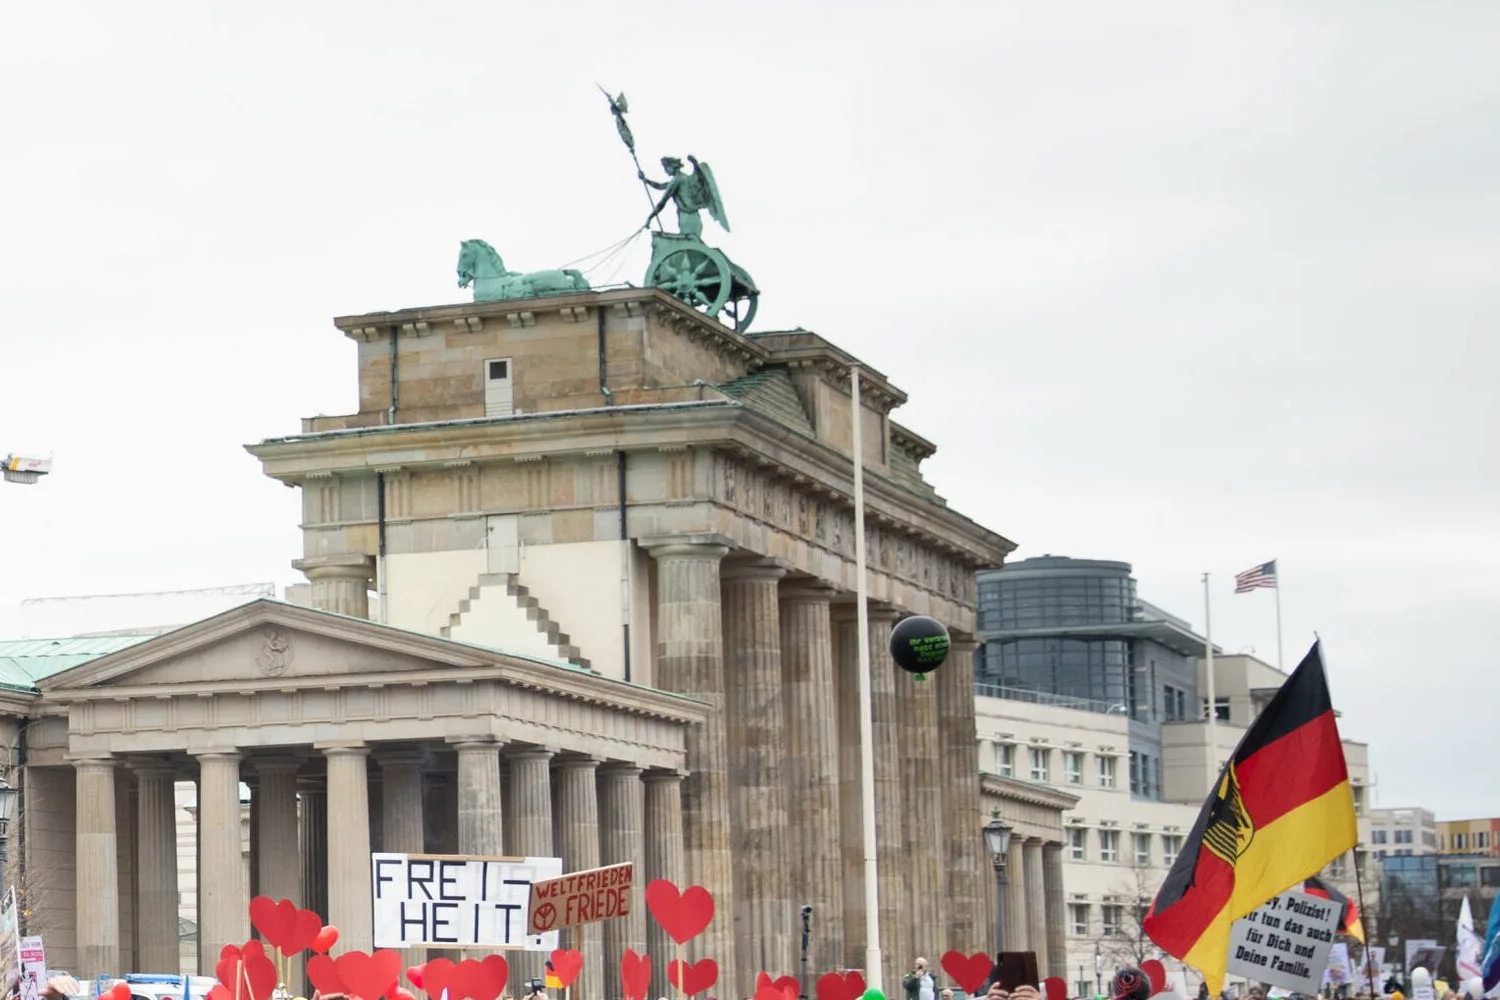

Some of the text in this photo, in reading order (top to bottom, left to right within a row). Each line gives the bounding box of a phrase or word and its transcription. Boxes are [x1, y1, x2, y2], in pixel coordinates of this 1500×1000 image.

[376, 859, 531, 902] FREI-
[535, 864, 633, 900] WELTFRIEDEN
[565, 885, 630, 925] FRIEDE
[1286, 897, 1331, 922] Polizist!
[401, 902, 541, 945] HEIT
[1243, 911, 1333, 943] ir tun das auch
[1246, 927, 1316, 959] für Dich und
[1235, 945, 1311, 979] Deine Familie.
